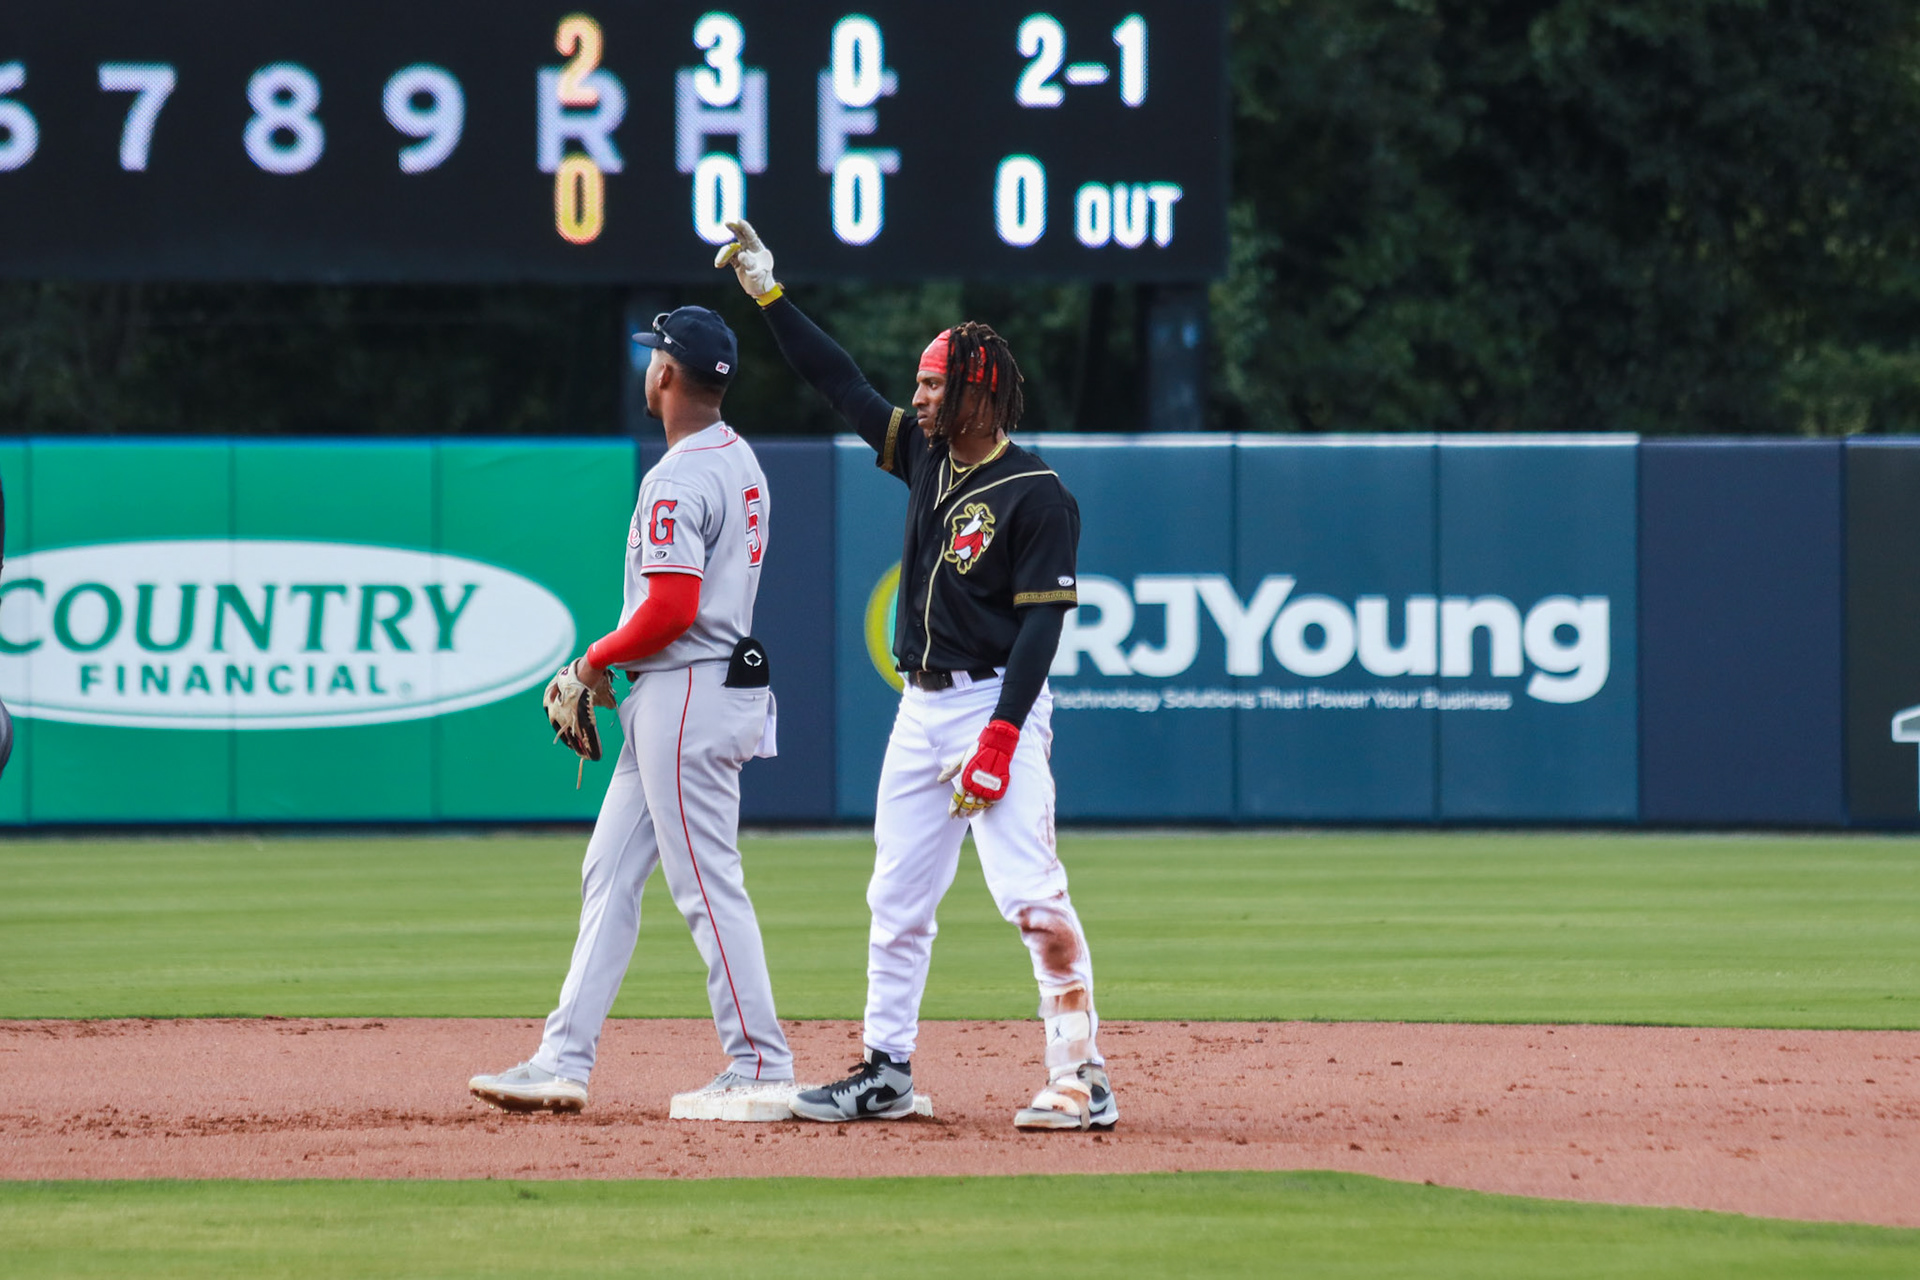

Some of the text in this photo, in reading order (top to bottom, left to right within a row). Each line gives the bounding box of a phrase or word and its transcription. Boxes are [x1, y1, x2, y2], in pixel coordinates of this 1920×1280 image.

[556, 11, 1150, 108] 2 3 0 2-1
[99, 62, 177, 173] 7
[243, 62, 325, 175] 8
[382, 63, 466, 174] 9
[536, 66, 628, 174] R
[675, 66, 768, 174] H
[555, 151, 1184, 249] 0 0 0 0 OUT
[649, 498, 678, 546] G
[742, 483, 762, 568] 5
[0, 577, 480, 655] COUNTRY
[1047, 575, 1609, 704] RJYoung
[79, 663, 388, 696] FINANCIAL
[1162, 686, 1256, 709] Solutions
[1259, 687, 1304, 709] That
[1306, 686, 1370, 710] Power
[1372, 687, 1419, 709] Your
[1421, 686, 1512, 711] Business
